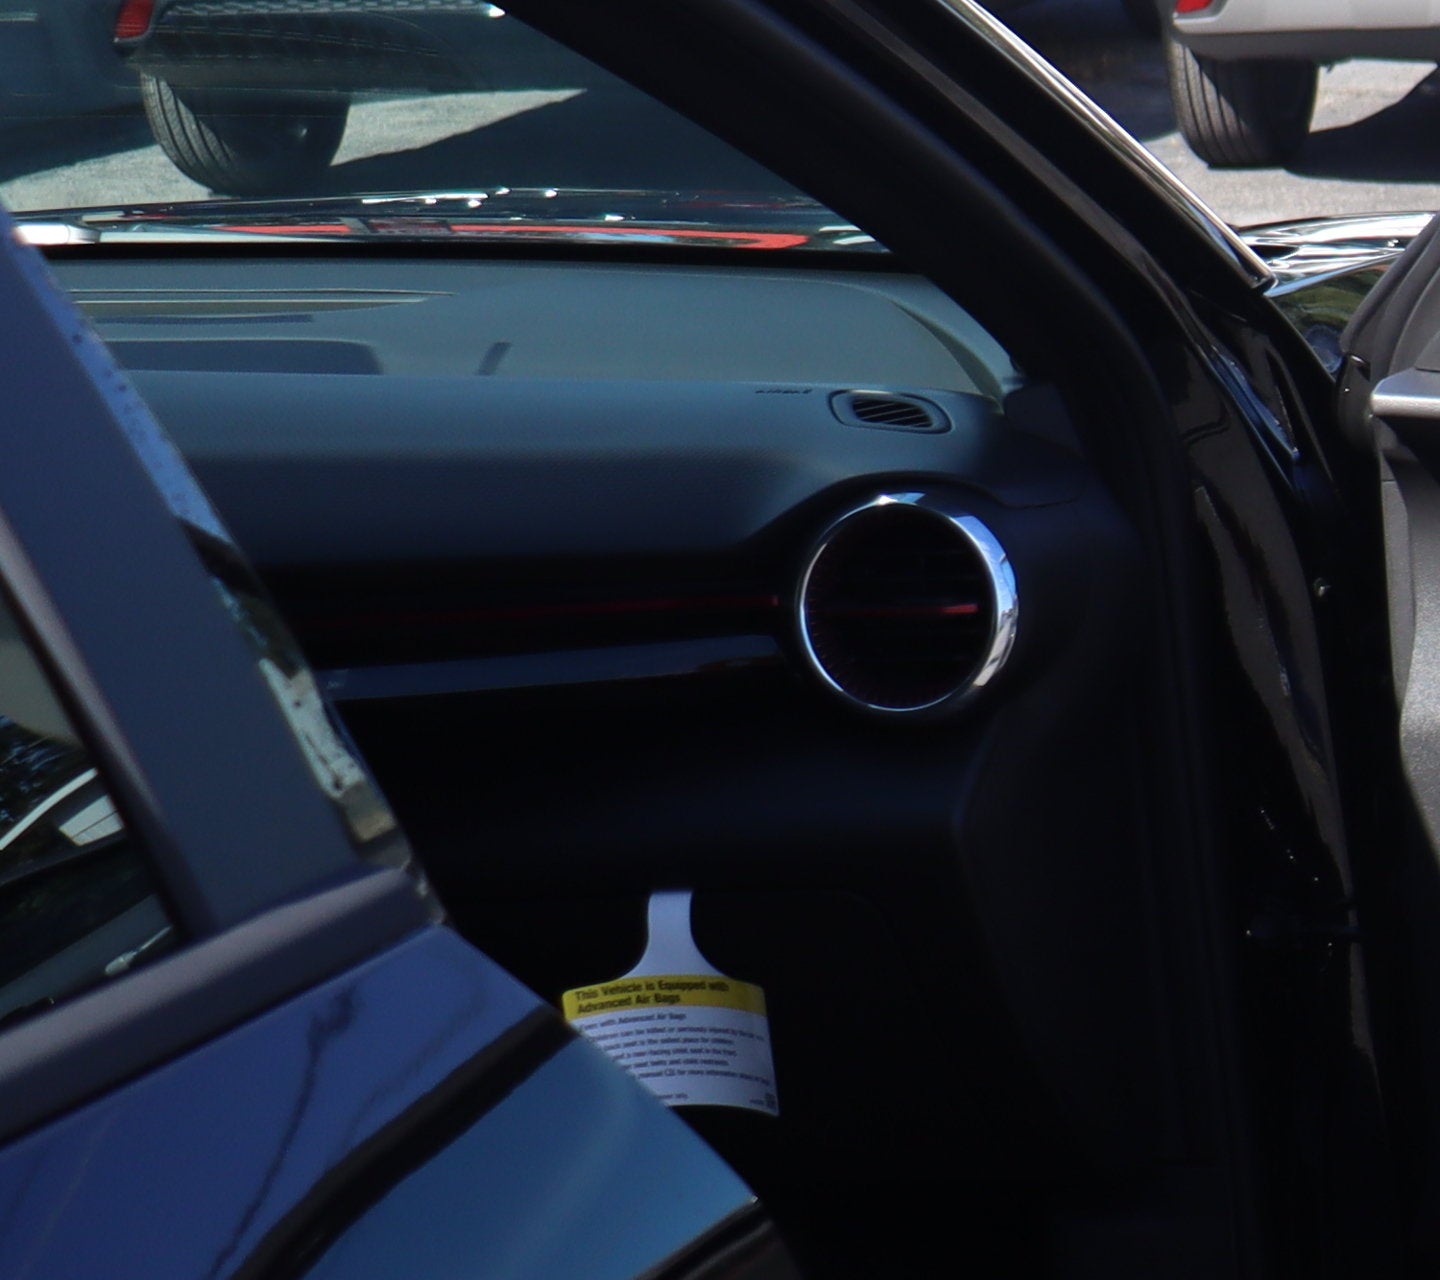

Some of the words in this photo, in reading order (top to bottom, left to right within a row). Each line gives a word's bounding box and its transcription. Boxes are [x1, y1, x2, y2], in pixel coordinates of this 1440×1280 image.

[575, 991, 599, 1000] This
[601, 983, 642, 996] Vehicle
[658, 980, 706, 993] Equipped
[578, 996, 632, 1014] Advanced
[636, 994, 651, 1005] Air
[654, 992, 681, 1005] Bags
